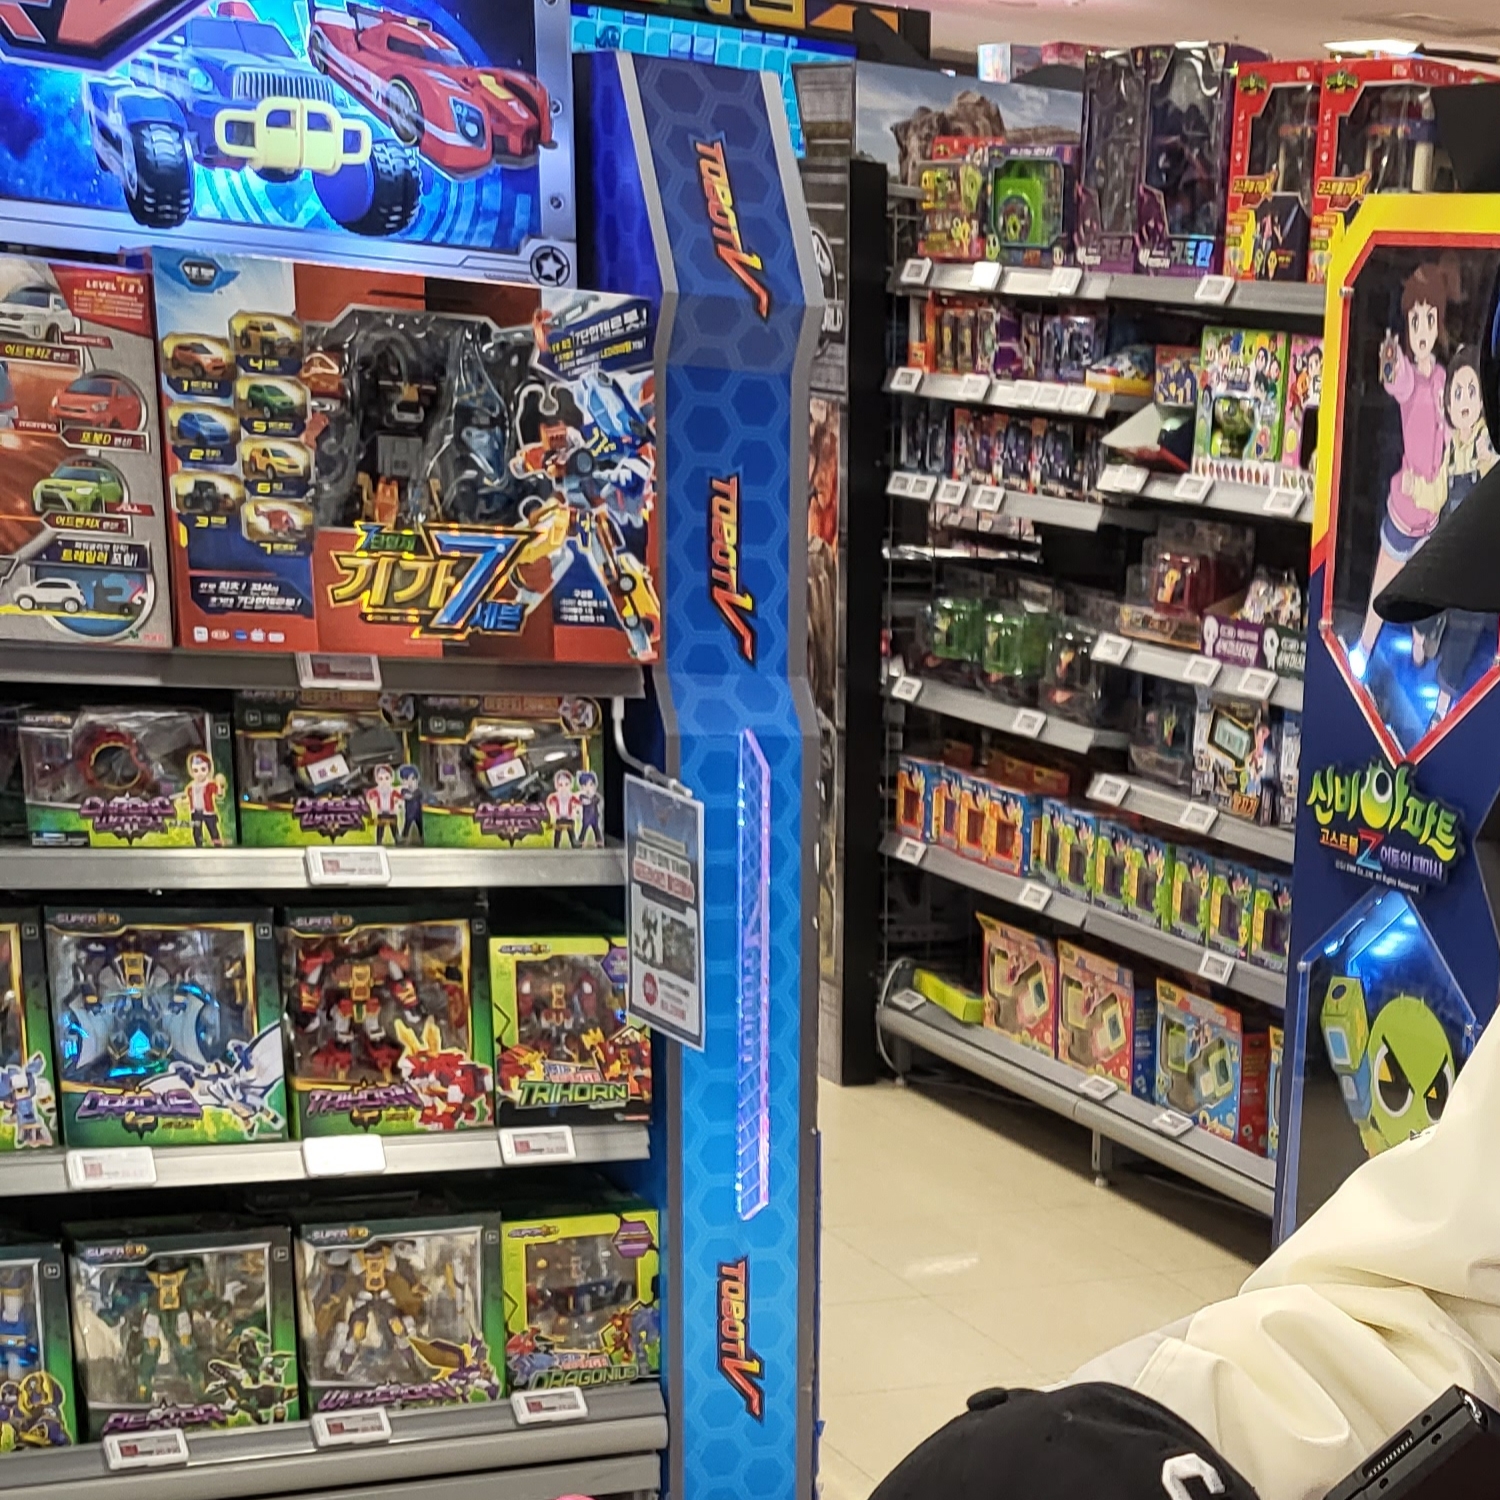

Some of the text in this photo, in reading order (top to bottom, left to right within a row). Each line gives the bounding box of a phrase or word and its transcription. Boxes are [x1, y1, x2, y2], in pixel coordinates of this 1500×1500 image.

[86, 279, 116, 290] LEVEL
[60, 549, 108, 564] 트레일러
[1306, 760, 1457, 862] 신비아파트
[519, 1081, 629, 1107] TRIHORN
[532, 1366, 638, 1391] DRAGONIUS
